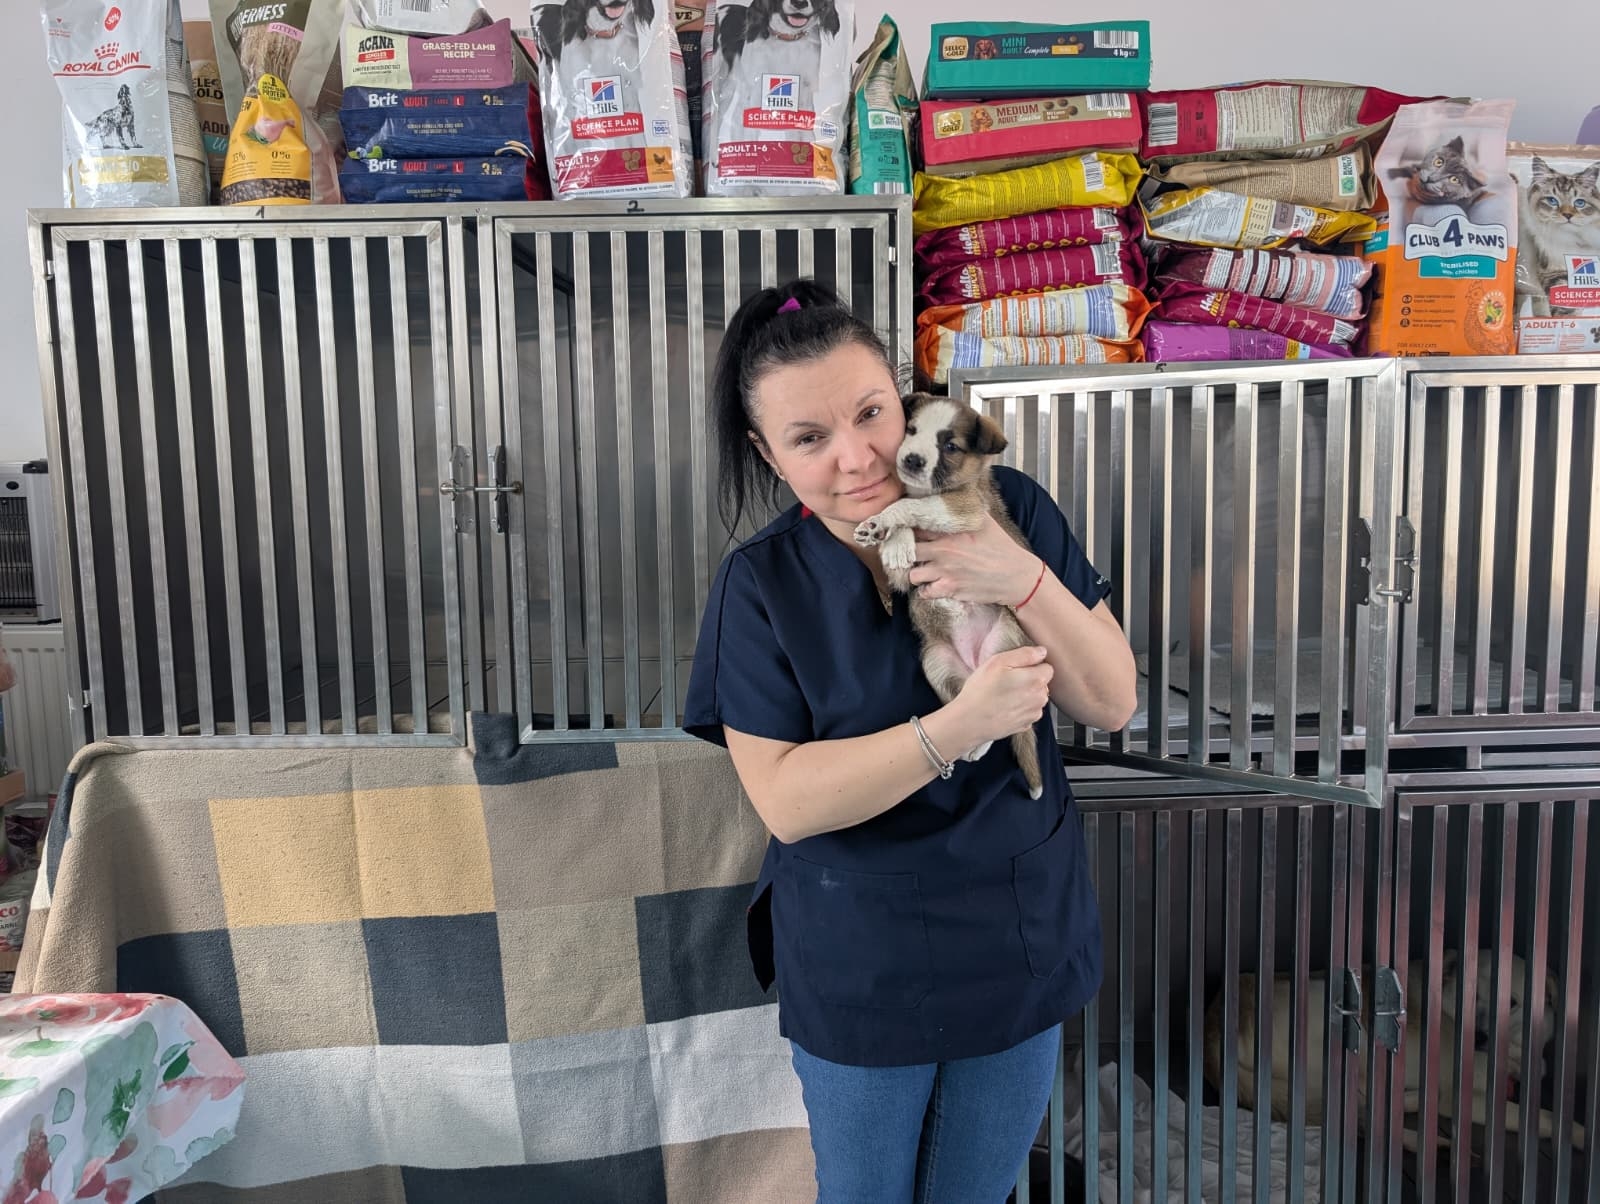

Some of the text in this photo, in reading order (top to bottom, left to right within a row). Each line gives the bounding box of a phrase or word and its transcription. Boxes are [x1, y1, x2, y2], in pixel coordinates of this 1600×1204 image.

[229, 3, 288, 41] DERNESS
[358, 35, 395, 53] ACANA
[422, 42, 496, 51] GRASS-FED LAMB
[1002, 37, 1026, 47] MINI
[1113, 48, 1129, 58] 4 kg
[63, 51, 140, 72] ROYAL CANIN
[193, 77, 222, 88] LEC
[196, 88, 223, 100] OLD
[368, 92, 398, 108] Brit
[592, 102, 618, 114] Hill's
[767, 97, 794, 108] Hill's
[996, 104, 1039, 117] MEDIUM
[748, 113, 811, 123] SCIENCE PLAN
[576, 118, 639, 132] SCIENCE PLAN
[942, 125, 960, 133] GOLD
[721, 144, 768, 154] ADULT 1-6
[271, 151, 291, 160] 0%
[558, 156, 584, 168] ADULT
[585, 155, 600, 164] 1-6
[368, 158, 397, 173] Brit
[627, 199, 645, 213] 2
[1410, 218, 1505, 249] CLUB 4 PAWS
[958, 226, 973, 255] Hello
[959, 266, 973, 298] Hello
[1573, 275, 1600, 286] Hill's
[1554, 291, 1593, 299] SCIENCE
[1199, 292, 1216, 311] Hel
[1525, 321, 1558, 329] ADULT
